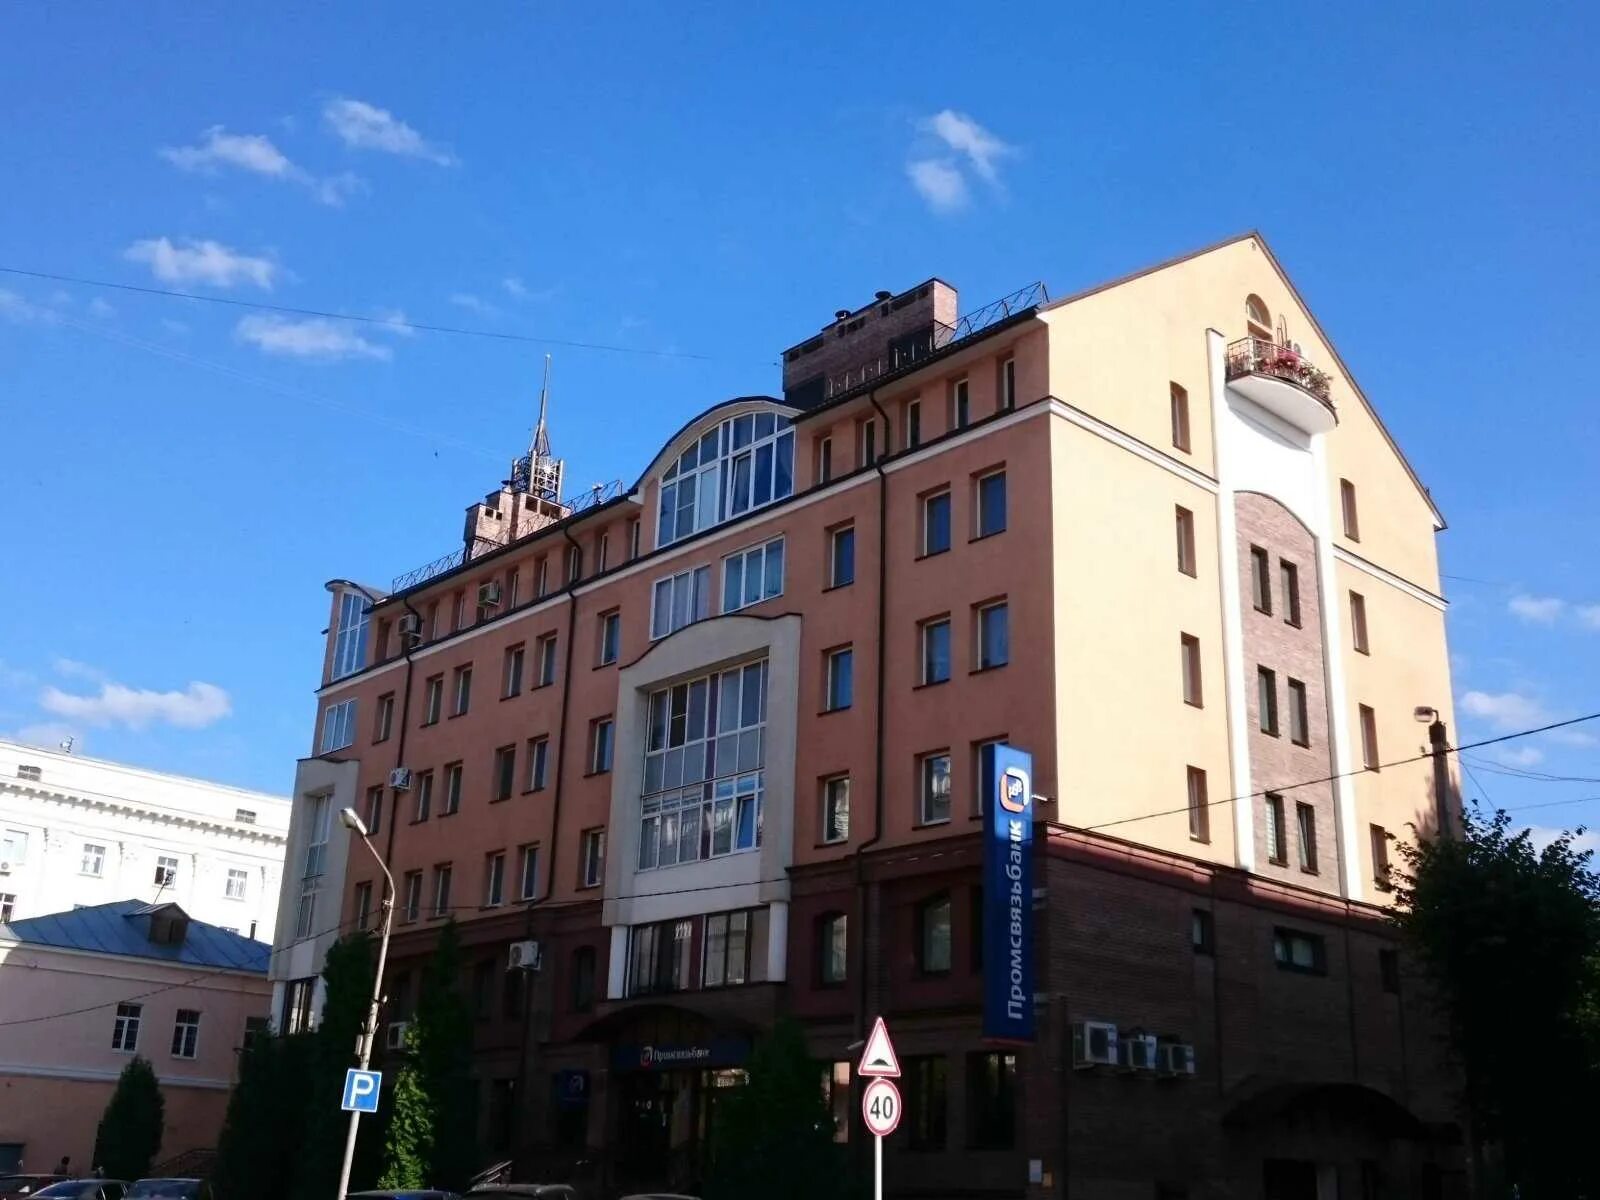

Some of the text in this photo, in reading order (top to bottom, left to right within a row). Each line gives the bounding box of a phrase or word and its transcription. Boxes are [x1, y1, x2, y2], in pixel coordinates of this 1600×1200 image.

[1006, 819, 1026, 1020] Промсвязьбанк
[350, 1074, 374, 1108] P
[870, 1095, 894, 1120] 40
